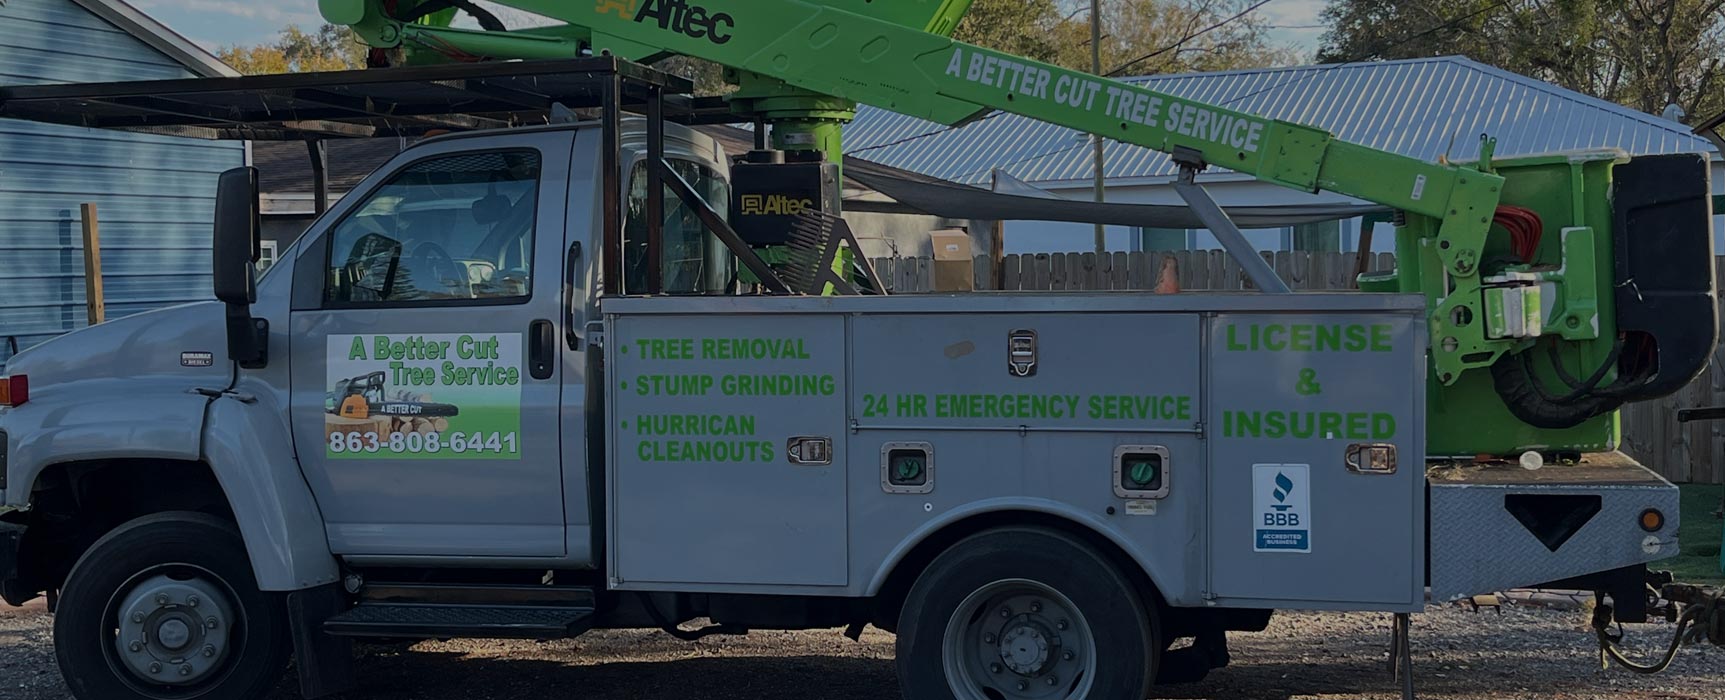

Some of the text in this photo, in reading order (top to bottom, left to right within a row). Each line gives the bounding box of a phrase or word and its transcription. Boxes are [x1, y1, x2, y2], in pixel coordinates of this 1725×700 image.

[634, 0, 734, 44] Altec
[945, 48, 1265, 153] A BETTER CUT TREE SERVICE
[763, 194, 812, 215] Altec
[349, 334, 499, 360] A Better Cut
[636, 338, 810, 359] TREE REMOVAL
[1227, 324, 1393, 352] LICENSE
[389, 361, 519, 386] Tree Service
[636, 374, 835, 396] STUMP GRINDING
[1296, 367, 1322, 395] &
[386, 404, 410, 414] BETTER
[410, 404, 422, 414] CUT
[862, 394, 1191, 420] 24 HR EMERGENCY SERVICE
[636, 414, 755, 435] HURRICAN
[1223, 410, 1396, 440] INSURED
[329, 431, 517, 453] 863-808-6441
[638, 440, 775, 462] CLEANOUTS
[1263, 512, 1300, 527] BBB
